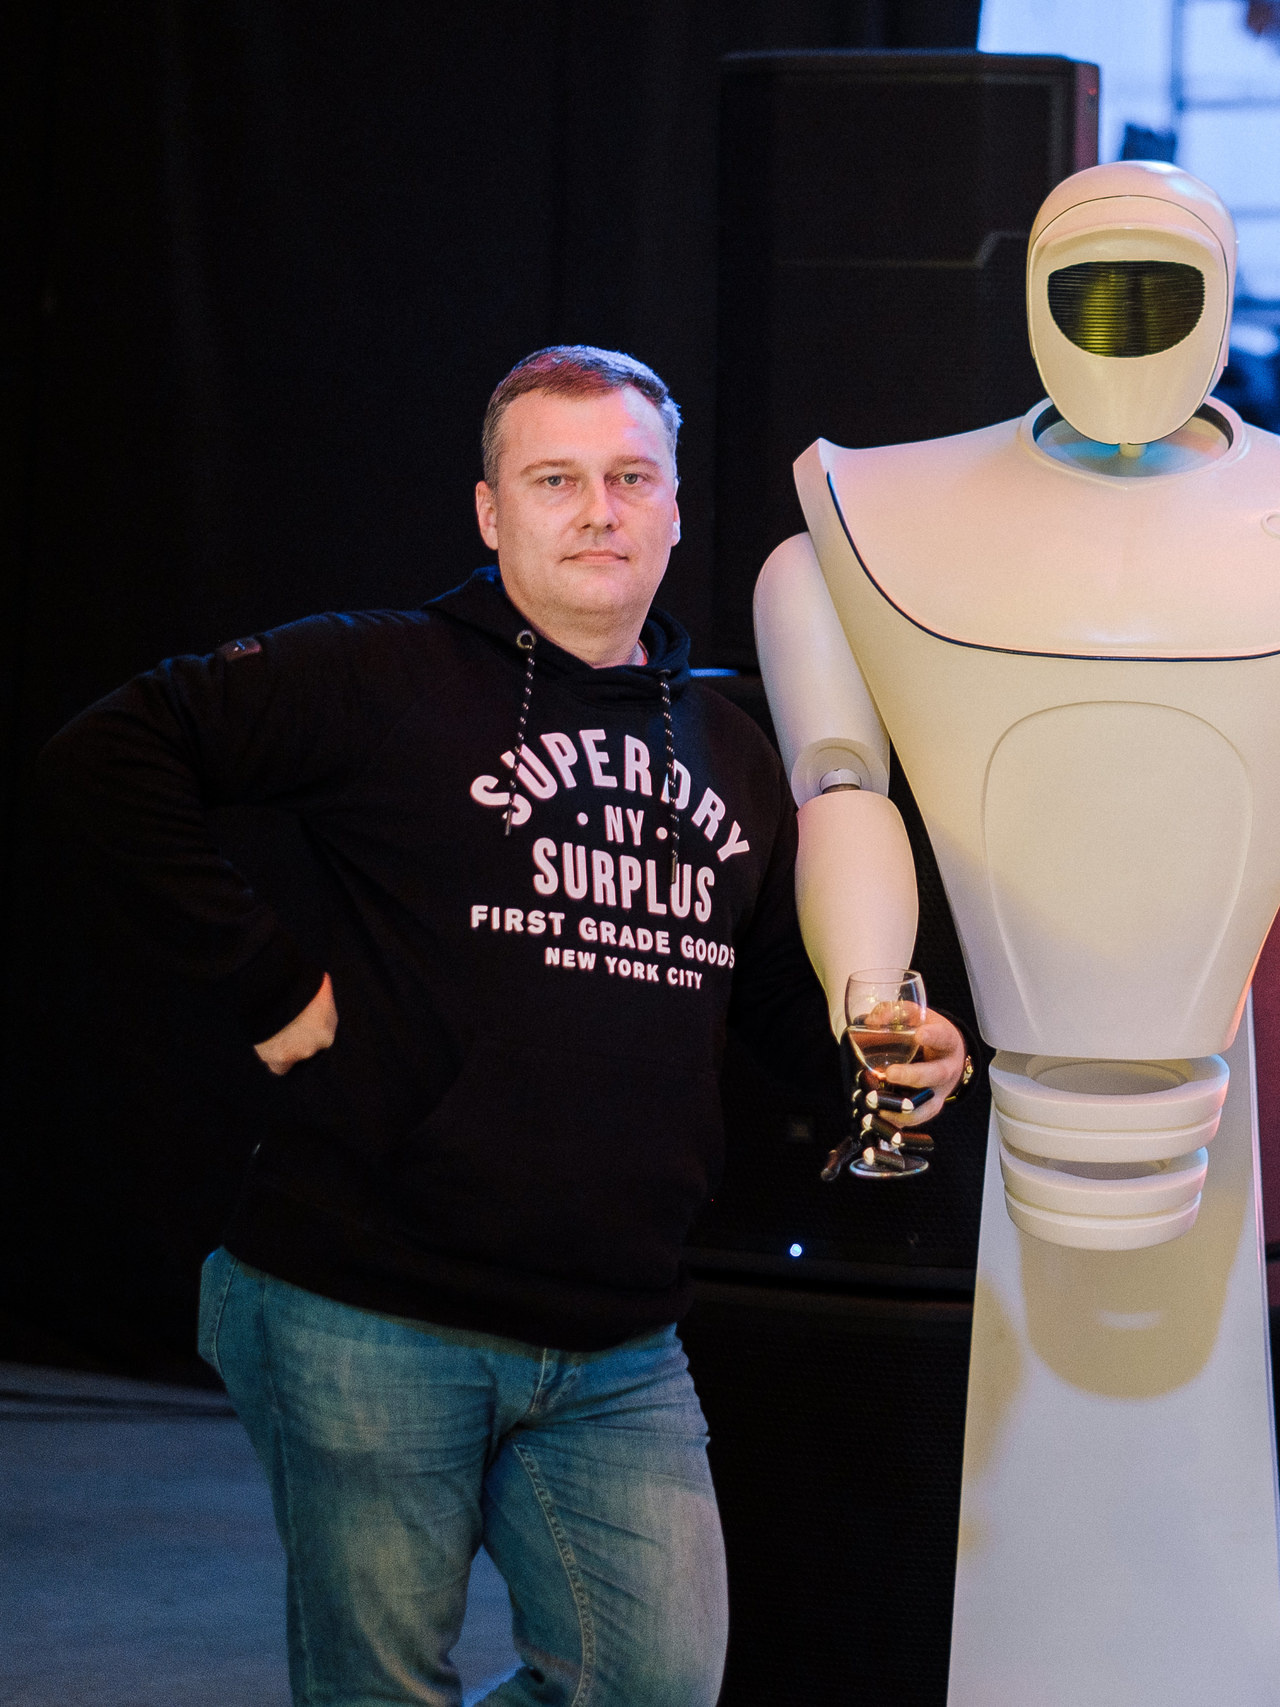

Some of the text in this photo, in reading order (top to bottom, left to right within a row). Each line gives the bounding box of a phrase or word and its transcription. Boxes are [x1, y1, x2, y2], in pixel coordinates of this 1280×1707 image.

[470, 729, 750, 862] SUPERDRY
[604, 805, 645, 846] NY
[532, 837, 715, 922] SURPLUS
[471, 905, 735, 969] FIRST GRADE GOODS
[545, 947, 702, 989] NEW YORK CITY
